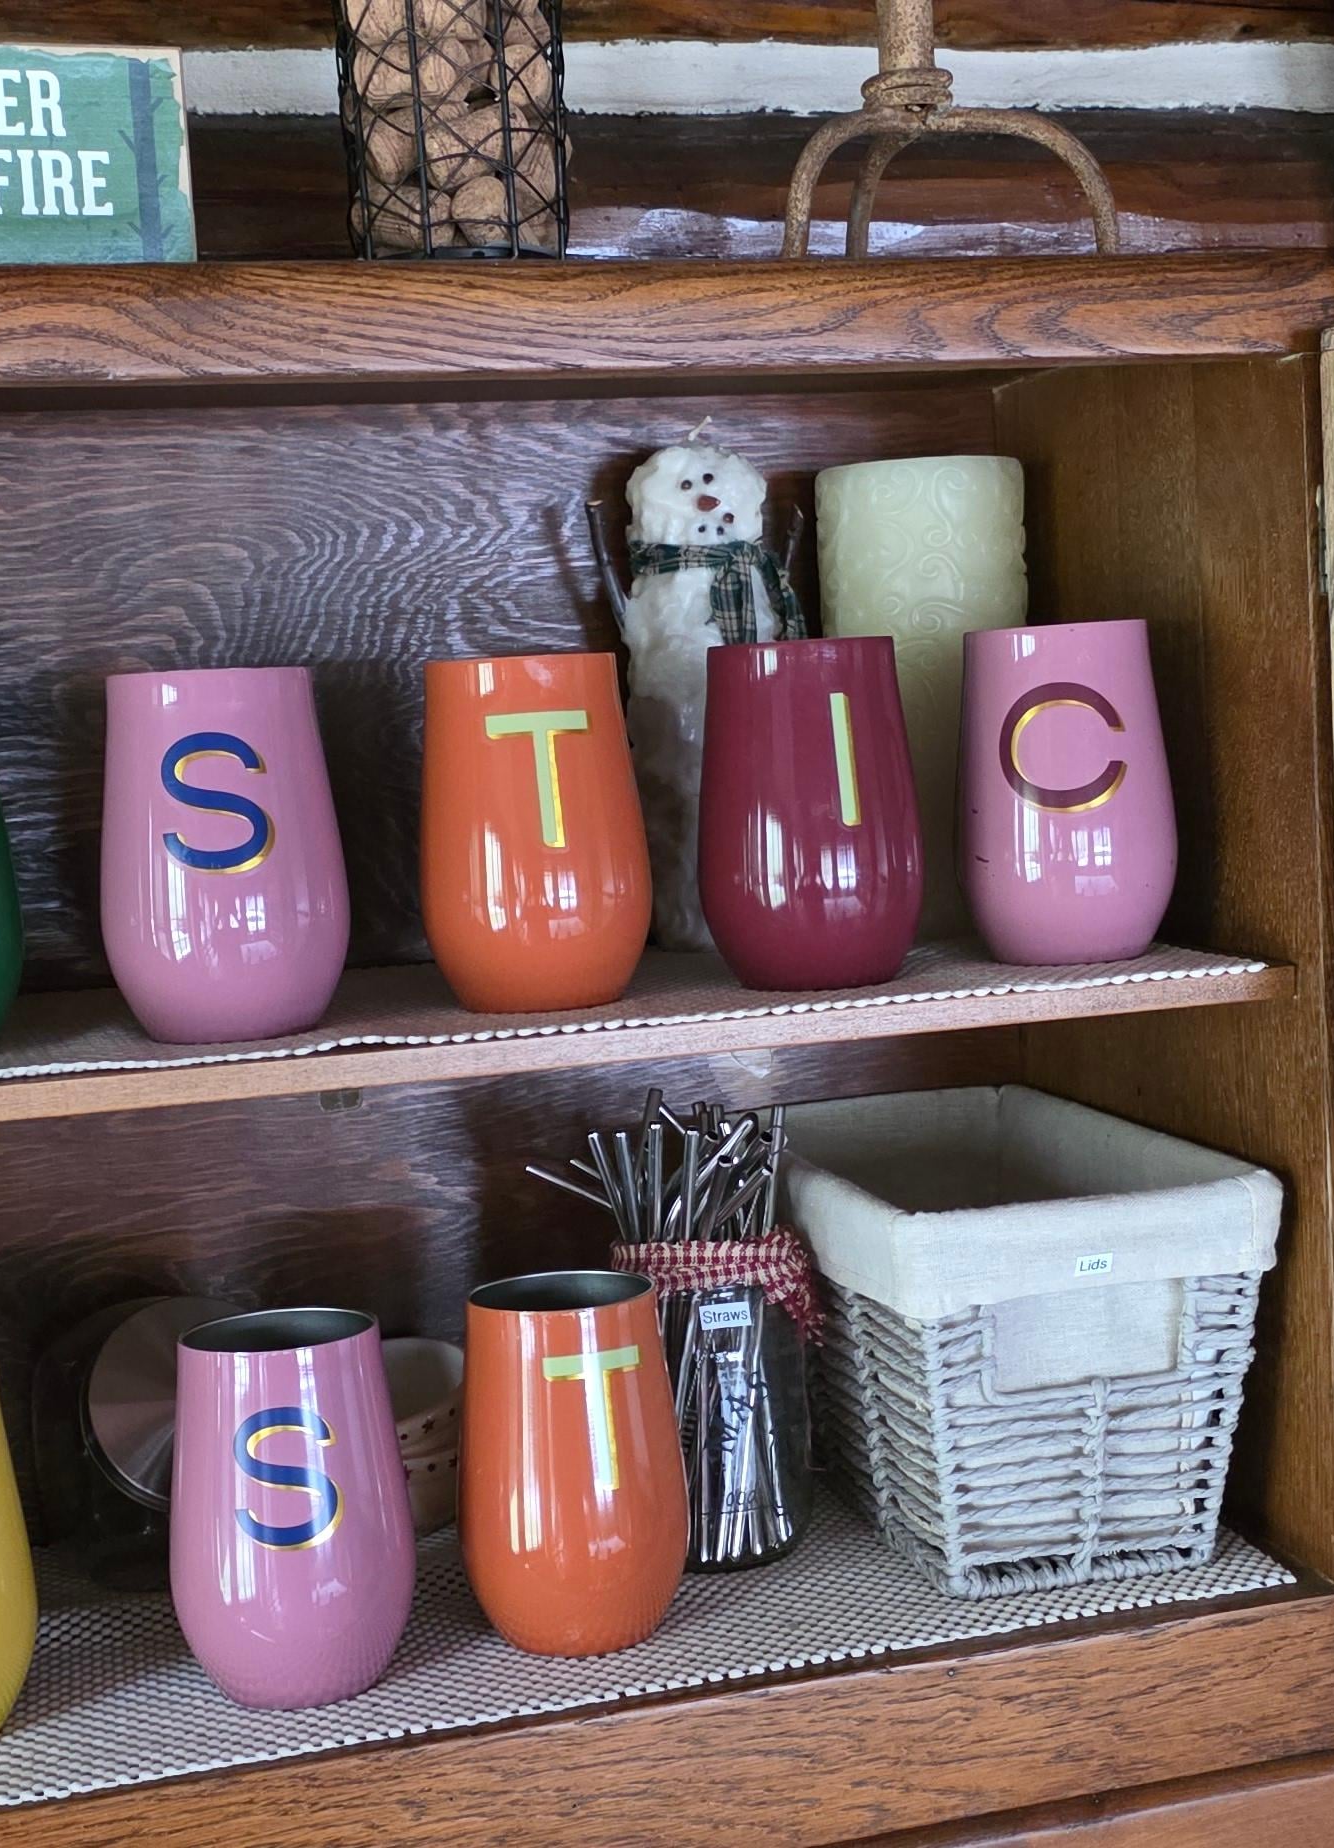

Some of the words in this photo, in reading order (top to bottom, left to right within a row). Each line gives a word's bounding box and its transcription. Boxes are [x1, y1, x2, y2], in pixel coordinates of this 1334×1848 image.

[160, 731, 276, 875] S
[484, 709, 588, 849] T
[829, 691, 863, 827] I
[998, 681, 1128, 813] C
[702, 1310, 749, 1324] Straws
[1079, 1258, 1108, 1272] Lids
[232, 1406, 344, 1552] S
[542, 1344, 640, 1490] T
